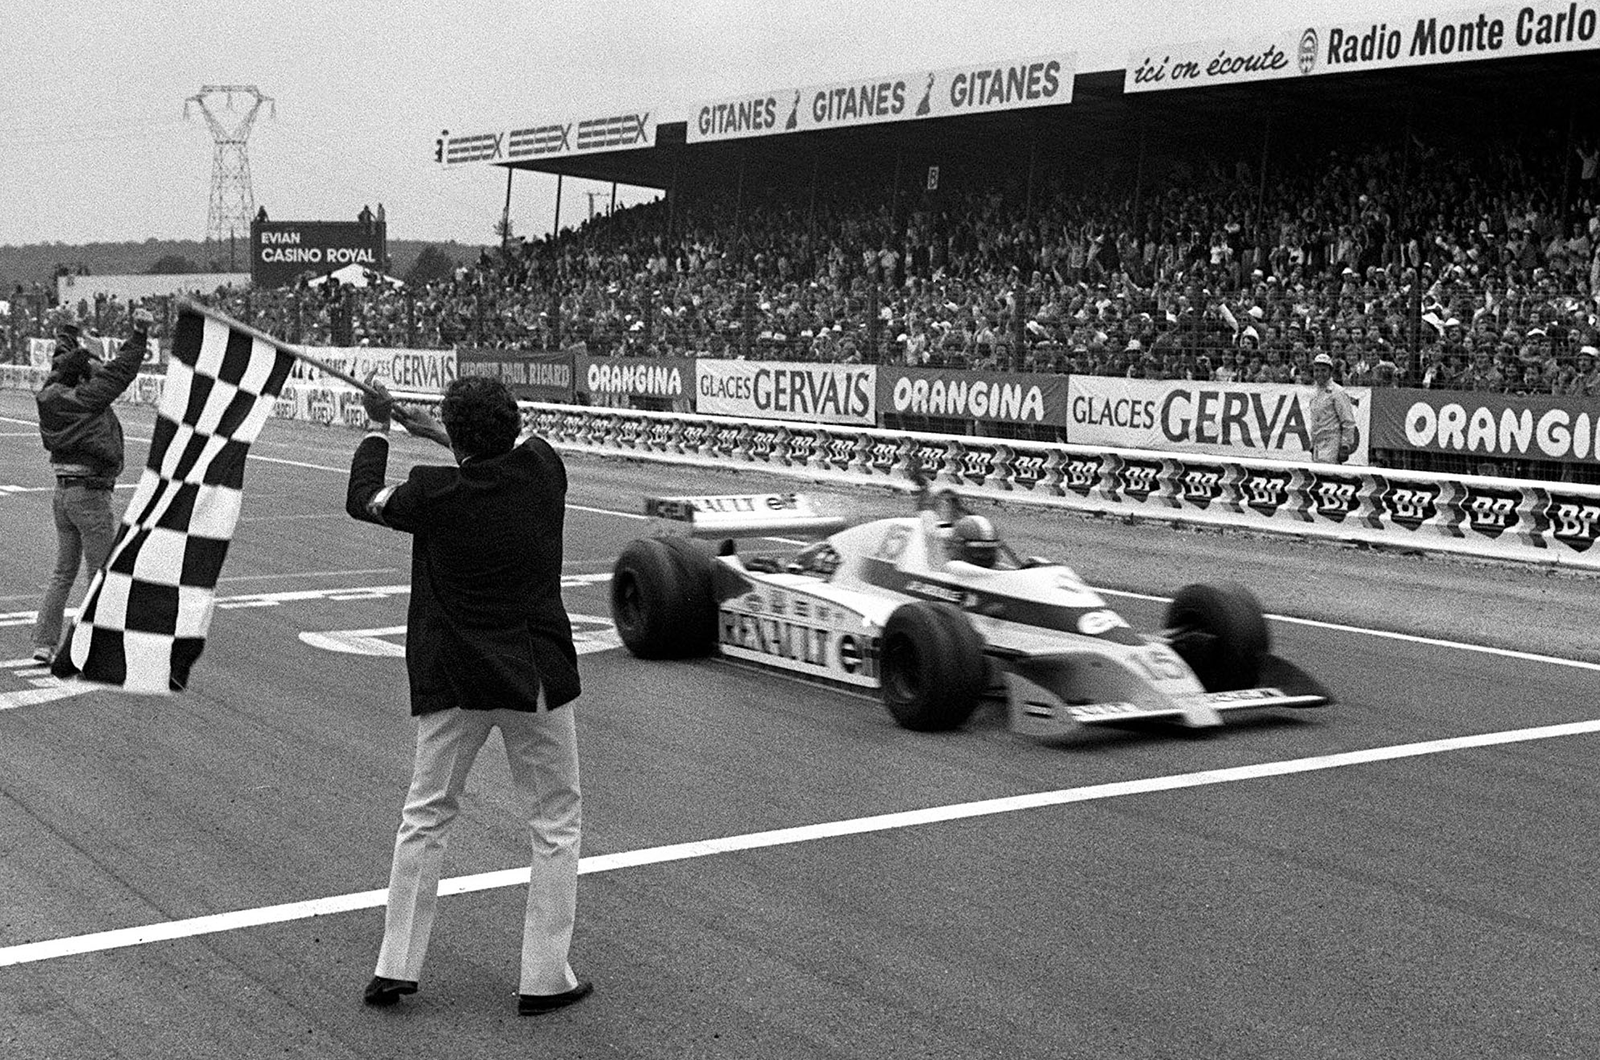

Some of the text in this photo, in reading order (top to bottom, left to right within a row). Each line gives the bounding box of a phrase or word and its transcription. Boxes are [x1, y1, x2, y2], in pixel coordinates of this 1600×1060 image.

[1134, 2, 1597, 83] ici on écoute Radio Monte Carlo
[698, 60, 1061, 135] GITANES GITANES GITANES
[261, 231, 300, 244] EVIAN
[261, 247, 376, 262] CASINO ROYAL
[391, 354, 457, 388] GERVAIS
[528, 363, 570, 388] RICARD
[587, 363, 682, 395] ORANGINA
[700, 368, 870, 418] GLACES GERVAIS
[893, 376, 1045, 421] ORANGINA
[1072, 395, 1156, 430] GLACES
[1404, 402, 1600, 462] ORANGI
[1068, 460, 1098, 485] BP
[1125, 466, 1157, 491] BP
[1185, 471, 1219, 497] BP
[1250, 476, 1285, 505] BP
[1318, 482, 1356, 510] BP
[1391, 489, 1432, 518] BP
[1471, 496, 1514, 526] BP
[1556, 503, 1600, 537] BP
